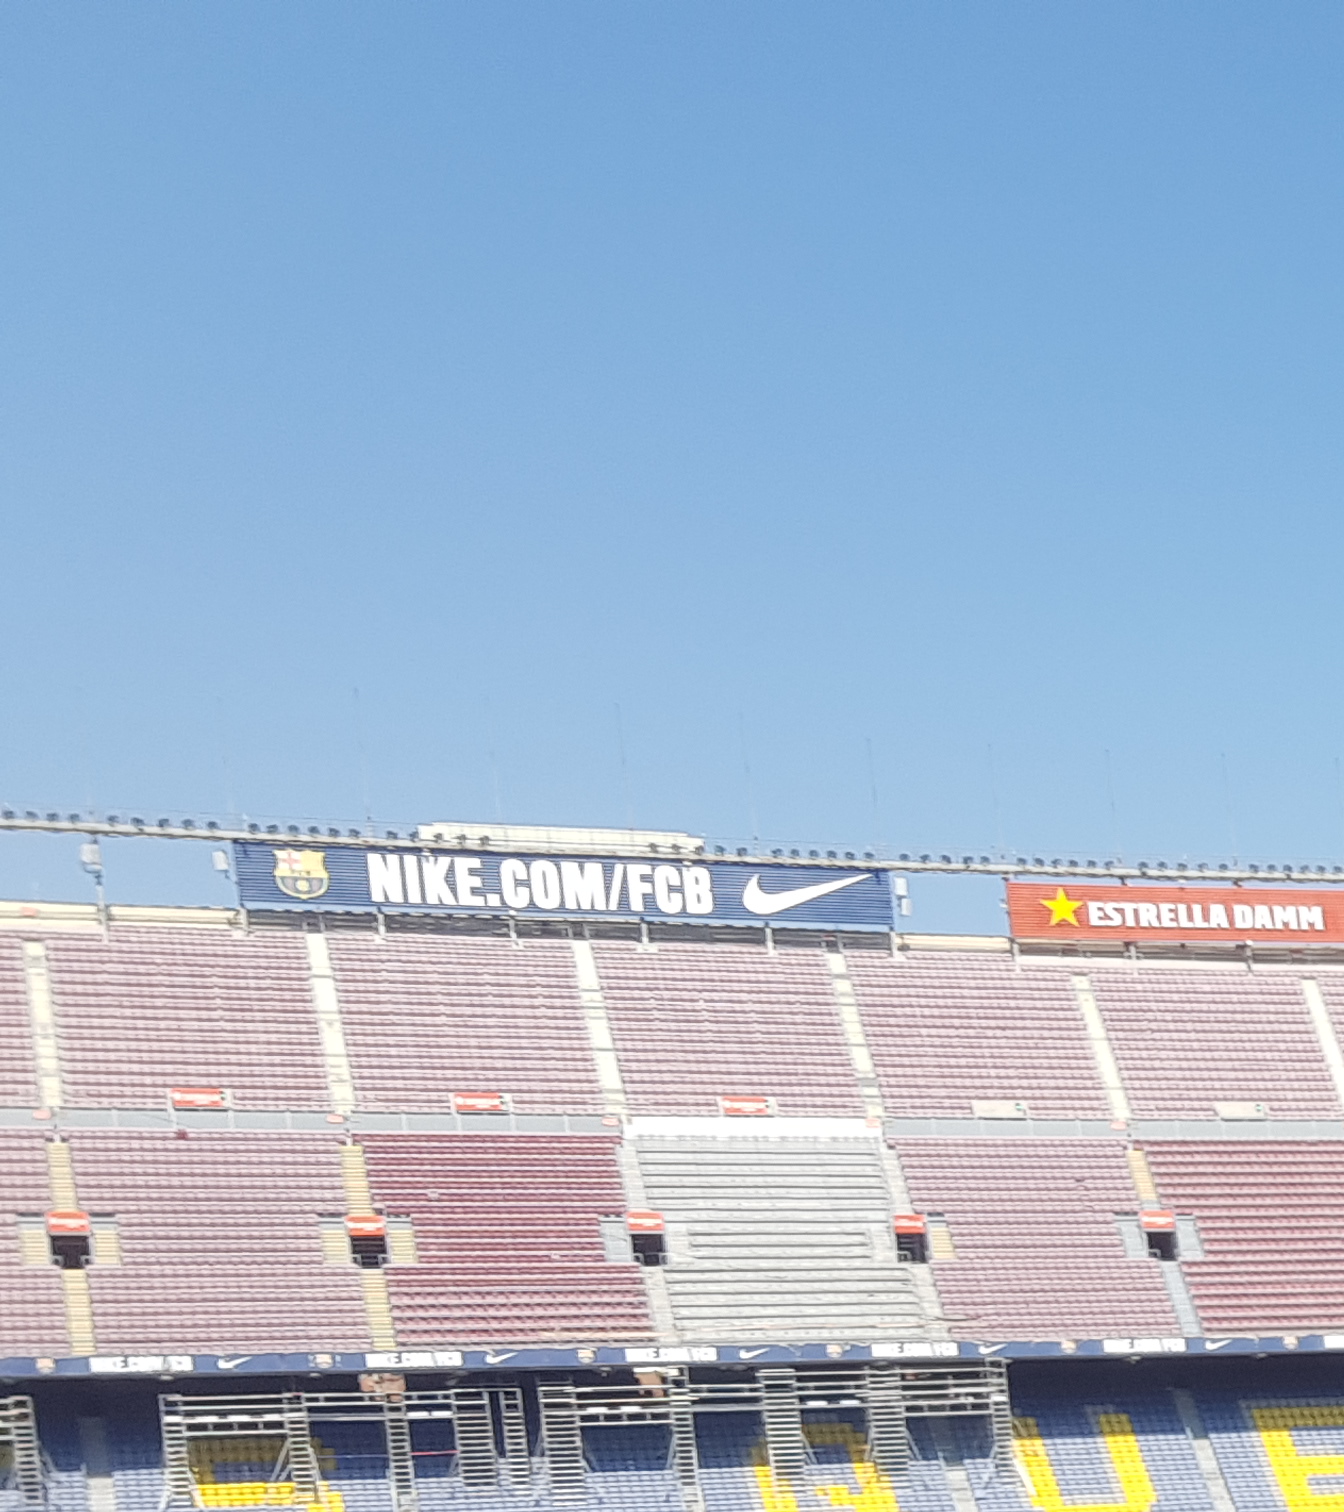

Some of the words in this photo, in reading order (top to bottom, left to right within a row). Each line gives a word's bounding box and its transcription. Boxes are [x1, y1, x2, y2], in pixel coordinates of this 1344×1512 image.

[366, 853, 714, 915] NIKE.COM/FCB
[1087, 901, 1229, 929] ESTRELLA
[1233, 904, 1326, 931] DAMM
